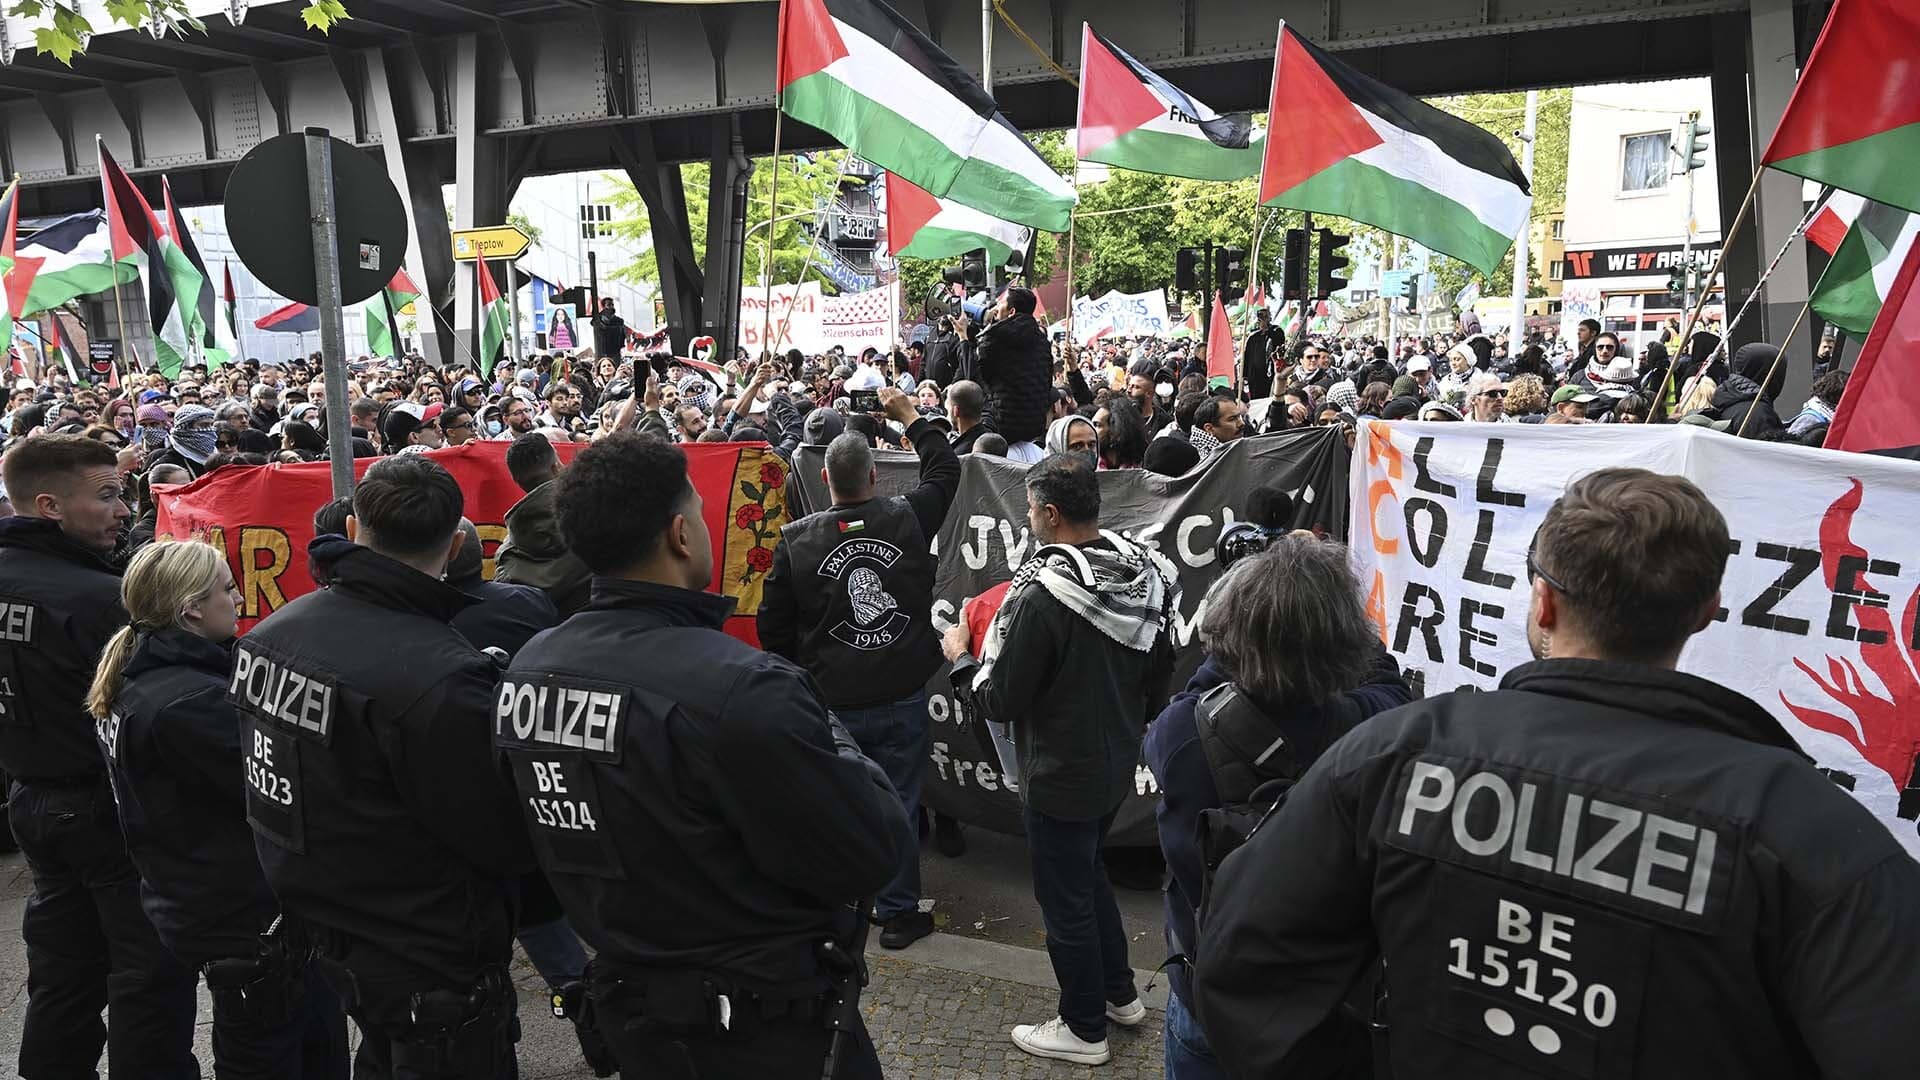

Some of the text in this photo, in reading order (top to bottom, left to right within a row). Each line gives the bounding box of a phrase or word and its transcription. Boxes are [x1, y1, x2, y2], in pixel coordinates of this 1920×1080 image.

[470, 239, 504, 251] Treptow
[741, 318, 792, 345] BAR
[826, 543, 894, 574] PALESTINE
[854, 629, 892, 647] 1948
[230, 648, 331, 735] POLIZEI
[497, 682, 621, 752] POLIZEI
[254, 729, 273, 767] BE
[246, 756, 293, 805] 15123
[532, 762, 567, 793] BE
[529, 797, 596, 831] 15124
[1398, 762, 1717, 915] POLIZEI
[1497, 899, 1575, 961] BE
[1447, 937, 1616, 1028] 15120
